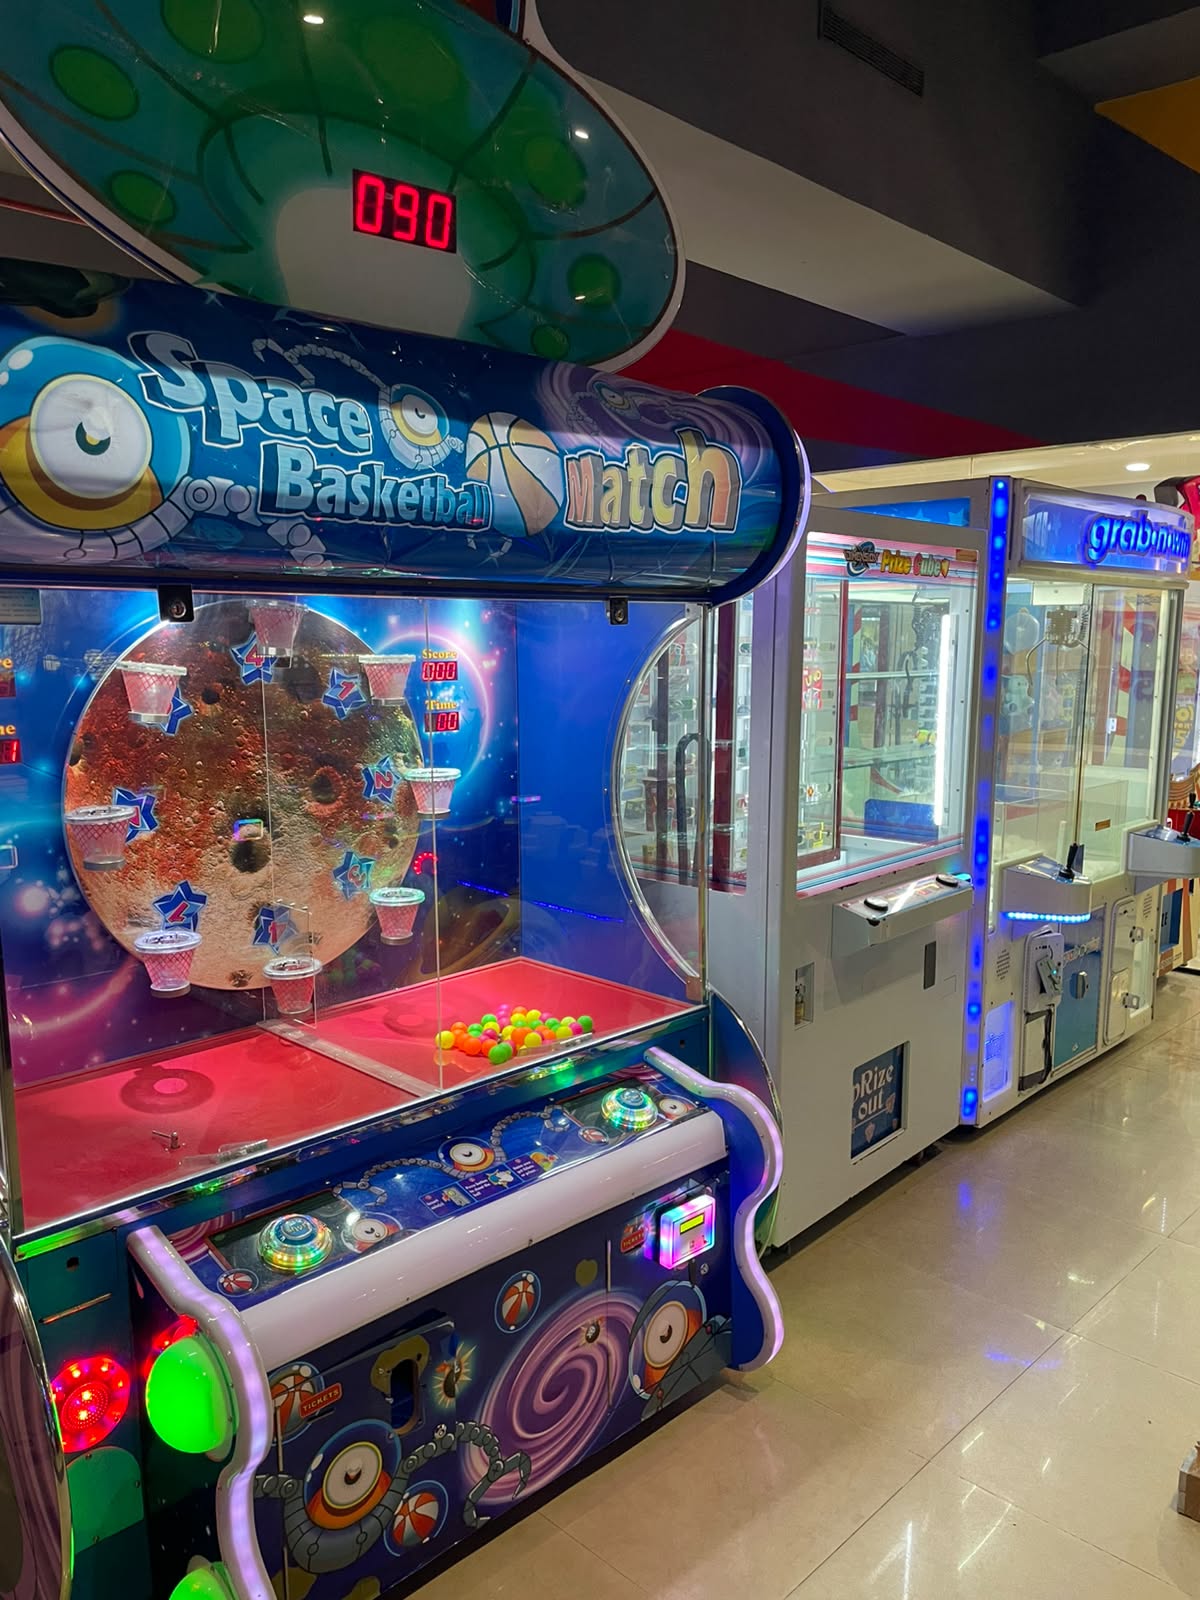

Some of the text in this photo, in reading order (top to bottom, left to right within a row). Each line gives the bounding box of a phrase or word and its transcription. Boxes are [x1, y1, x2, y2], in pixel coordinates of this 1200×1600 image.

[356, 174, 453, 250] 090
[129, 331, 373, 455] Space
[259, 442, 491, 531] Basketball
[564, 428, 742, 534] Match
[880, 549, 912, 575] Prize
[913, 553, 941, 577] Cube
[302, 1388, 339, 1412] TICKETS
